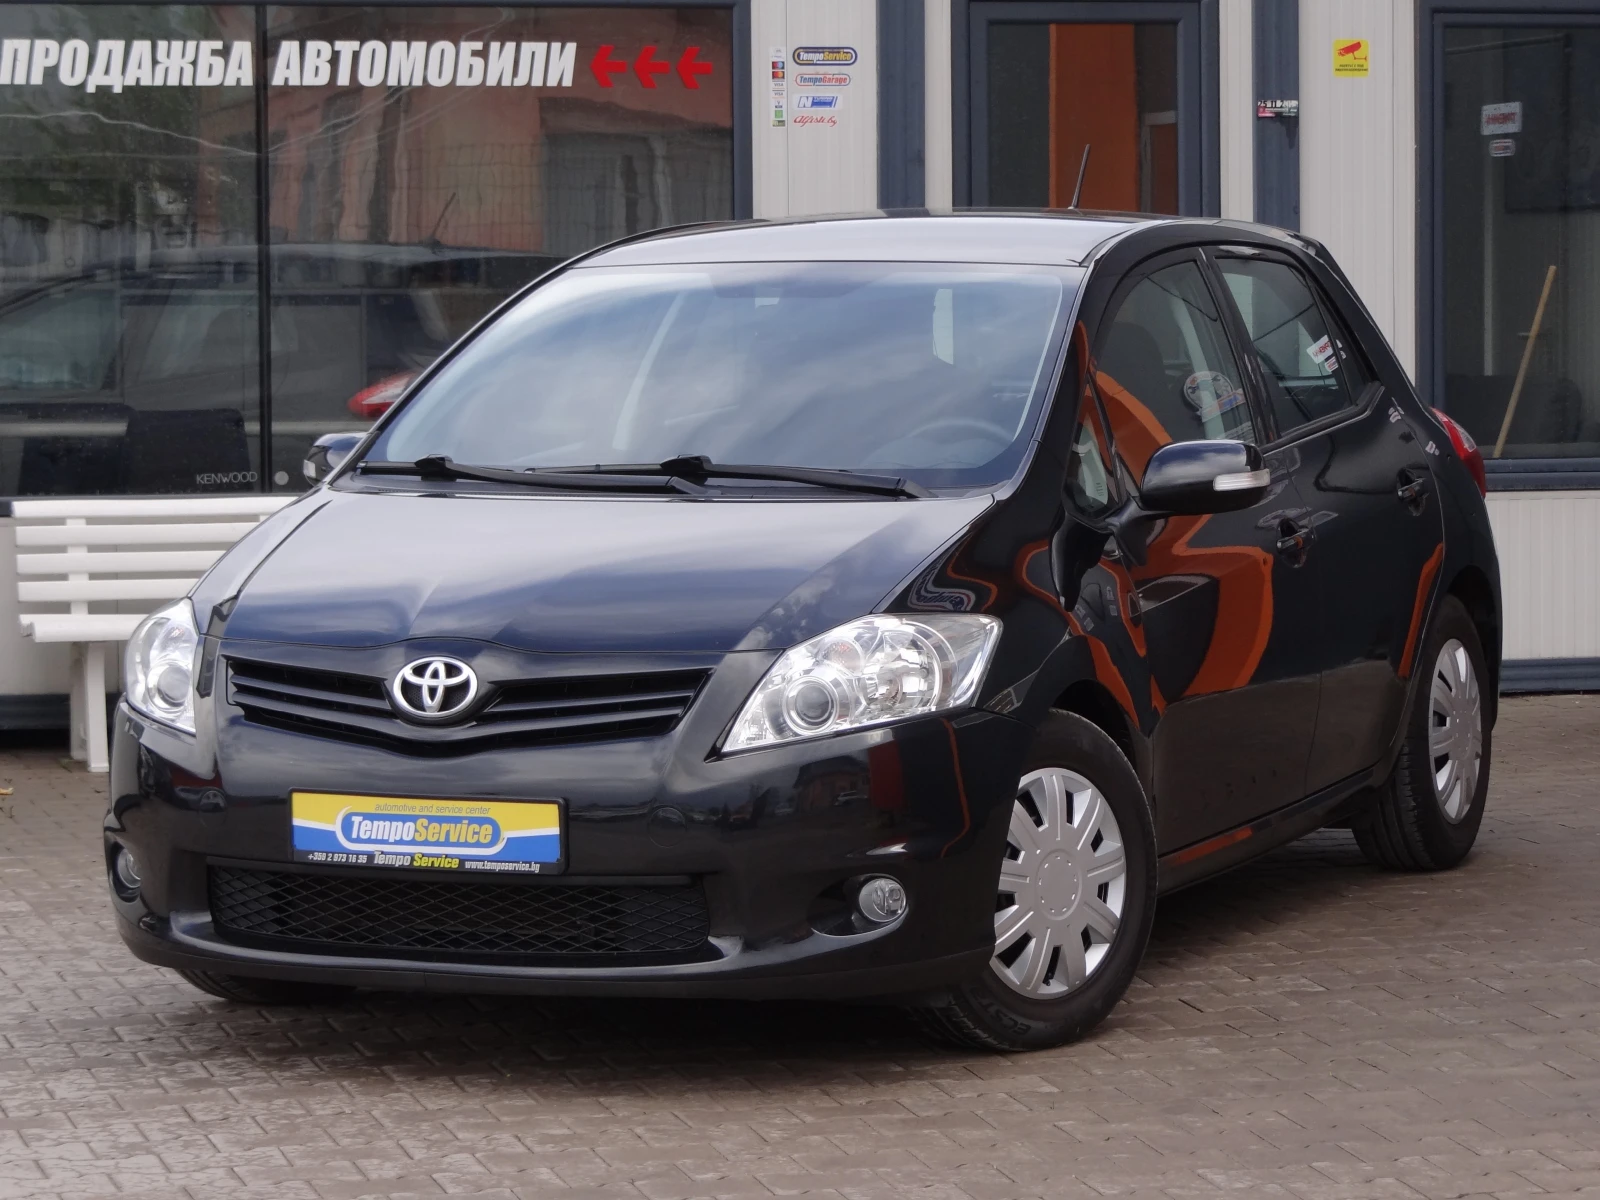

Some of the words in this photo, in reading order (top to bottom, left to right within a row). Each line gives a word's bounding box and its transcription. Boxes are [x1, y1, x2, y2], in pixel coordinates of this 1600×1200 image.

[800, 51, 851, 63] TempoService
[0, 39, 253, 94] ПРОДАЖБА
[271, 40, 578, 87] АВТОМОБИЛИ
[800, 76, 847, 86] TempoGarage
[196, 471, 258, 484] KENWOOD
[374, 803, 416, 812] automotive
[418, 804, 433, 813] and
[435, 805, 463, 814] service
[466, 806, 491, 814] center
[351, 815, 493, 844] TempoService
[308, 852, 326, 861] +359
[374, 850, 411, 867] Tempo
[413, 852, 460, 868] Service
[465, 860, 540, 873] www.temposervice.bg
